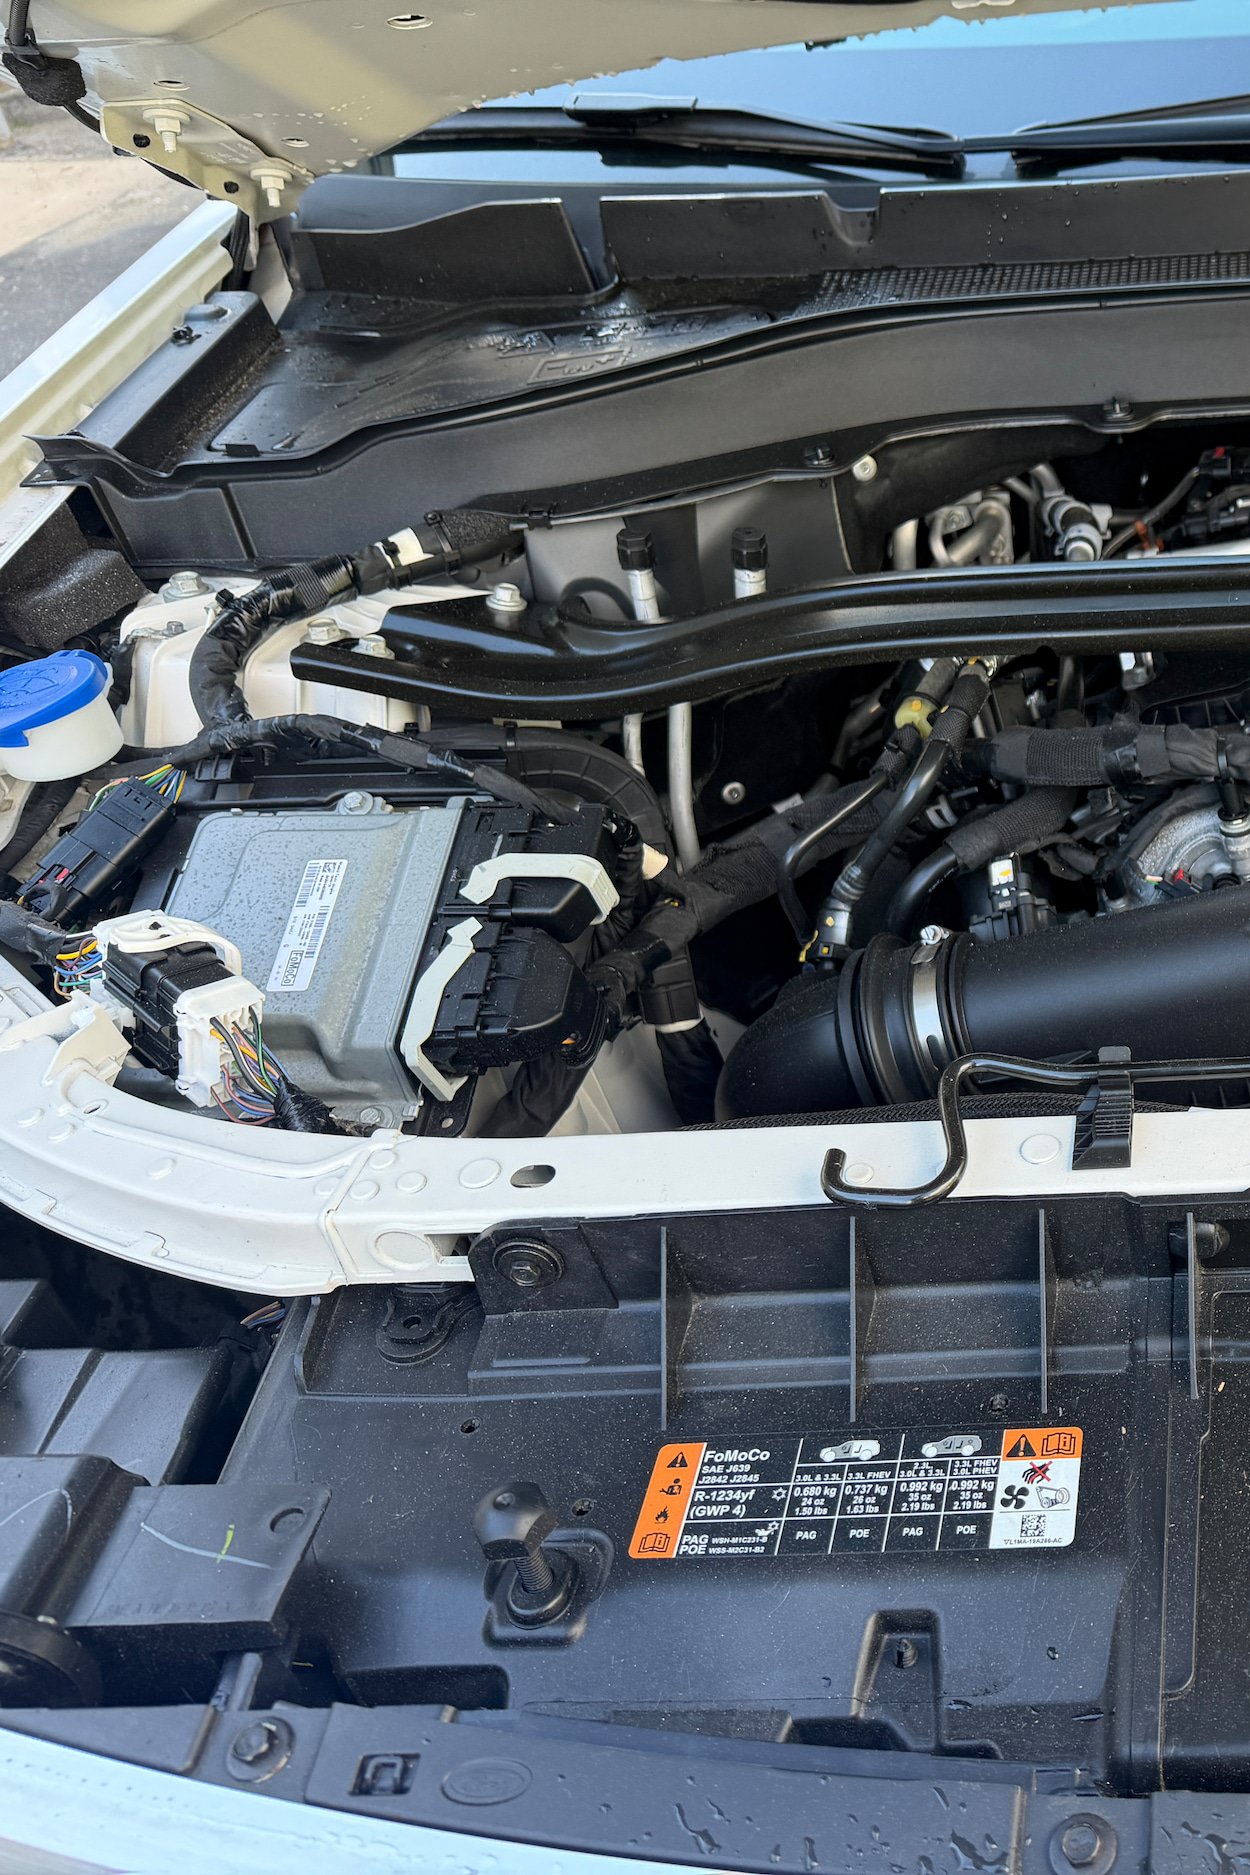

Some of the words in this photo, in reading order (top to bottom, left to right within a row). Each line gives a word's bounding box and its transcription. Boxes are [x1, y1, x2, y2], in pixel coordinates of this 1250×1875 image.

[283, 952, 303, 984] FoMoCo
[703, 1448, 771, 1463] FoMoCo
[954, 1460, 972, 1468] 3.3L
[973, 1459, 998, 1467] FHEV
[701, 1465, 724, 1474] SAE
[726, 1464, 751, 1473] J639
[953, 1467, 971, 1475] 3.0L
[972, 1466, 997, 1475] PHEV
[795, 1474, 813, 1482] 3.0L
[824, 1473, 842, 1481] 3.3L
[847, 1472, 865, 1480] 3.3L
[866, 1471, 891, 1479] FHEV
[899, 1470, 917, 1478] 3.0L
[698, 1475, 728, 1484] J2842
[730, 1474, 760, 1483] J2845
[845, 1485, 873, 1495] 0.737
[874, 1484, 888, 1495] kg
[900, 1482, 928, 1492] 0.992
[930, 1481, 943, 1493] kg
[952, 1480, 980, 1490] 0.992
[981, 1480, 995, 1491] kg
[694, 1489, 756, 1504] R-1234yf
[793, 1486, 822, 1497] 0.680
[824, 1486, 837, 1498] kg
[959, 1492, 971, 1500] 35
[908, 1493, 920, 1501] 35
[801, 1498, 813, 1506] 24
[952, 1501, 972, 1510] 2.19
[973, 1501, 987, 1509] lbs
[795, 1507, 813, 1515] 1.50
[814, 1507, 828, 1515] lbs
[865, 1505, 879, 1513] lbs
[901, 1503, 920, 1511] 2.19
[689, 1507, 730, 1519] (GWP
[732, 1506, 747, 1518] 4)
[849, 1529, 870, 1538] POE
[902, 1527, 924, 1536] PAG
[956, 1526, 977, 1534] POE
[796, 1530, 817, 1540] PAG
[681, 1535, 709, 1545] PAG
[679, 1545, 706, 1555] POE
